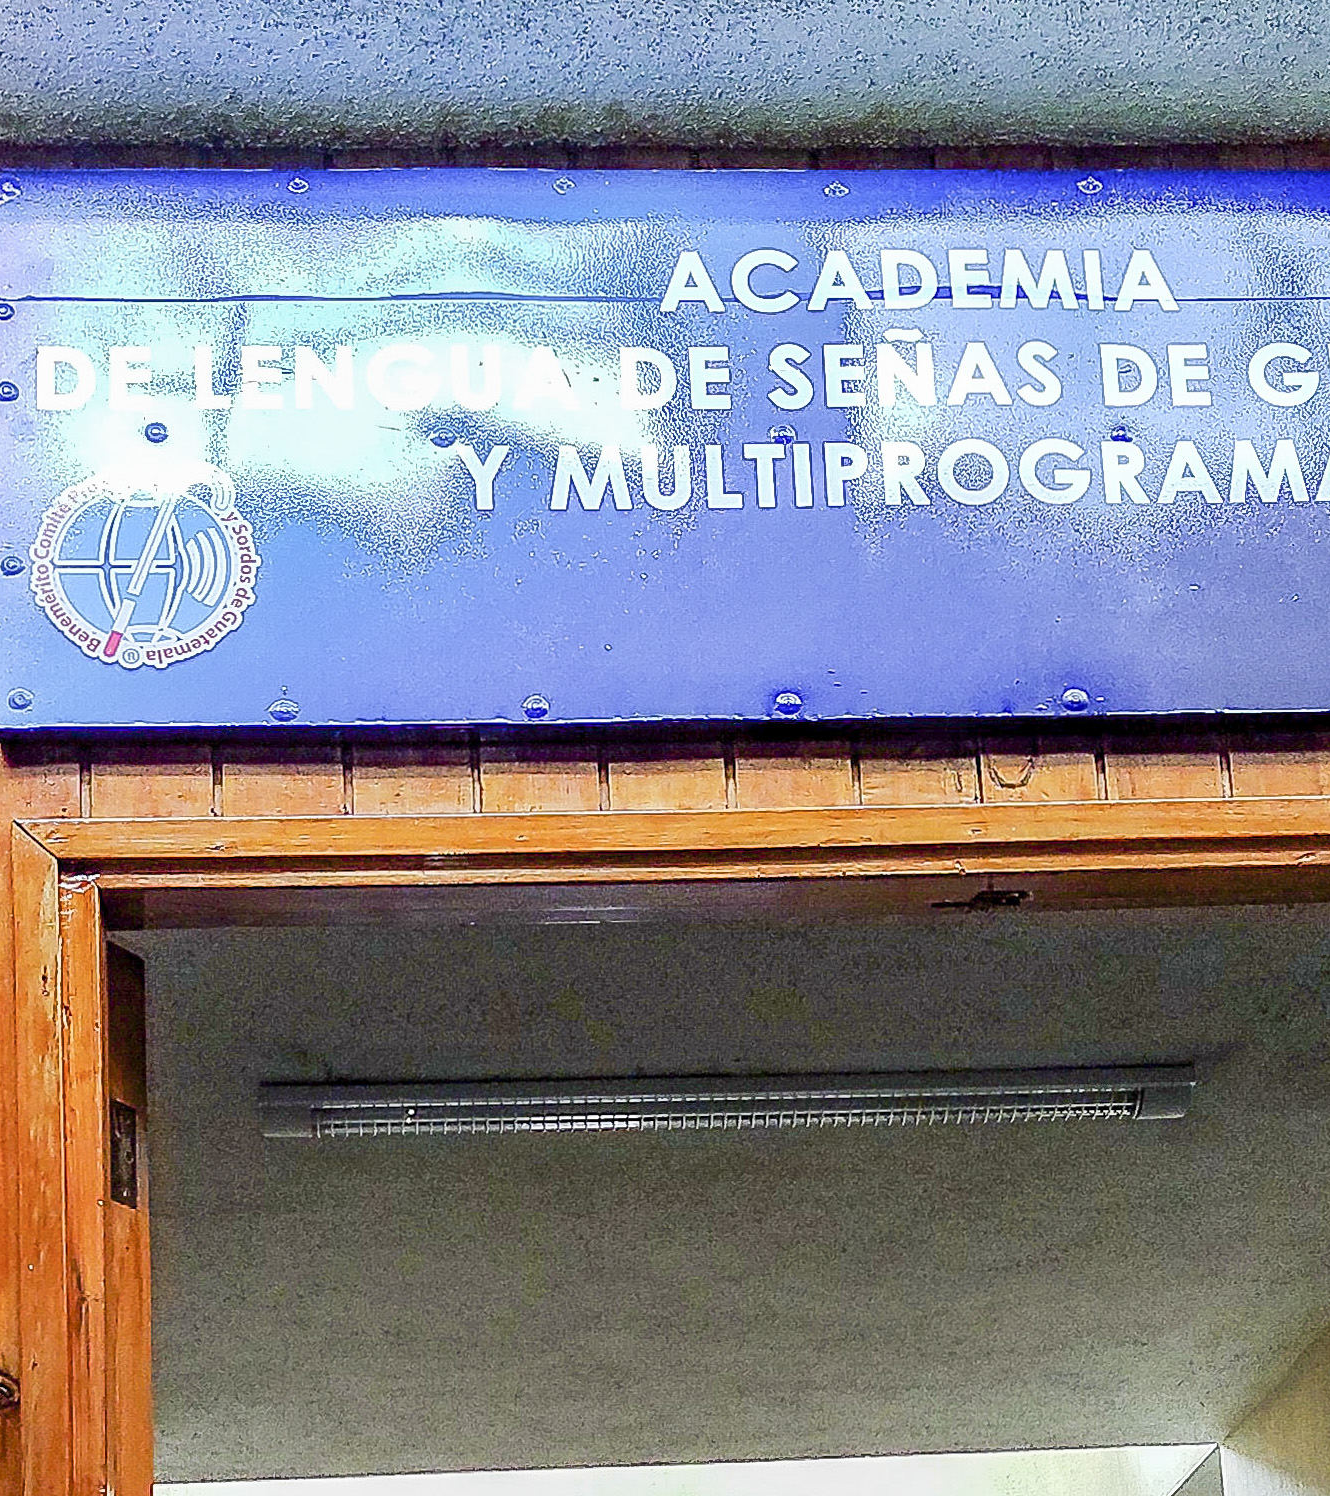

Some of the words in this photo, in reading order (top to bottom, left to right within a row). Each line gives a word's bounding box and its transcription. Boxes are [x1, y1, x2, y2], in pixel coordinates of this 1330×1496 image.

[659, 248, 1180, 313] ACADEMIA
[35, 344, 152, 411] DE
[194, 343, 584, 411] LENGUA
[620, 345, 732, 410] DE
[768, 327, 1063, 410] SEÑAS
[1099, 342, 1213, 407] DE
[458, 444, 510, 511] Y
[221, 512, 238, 522] y
[231, 524, 256, 584] Sordos
[35, 562, 102, 652] Benemérito
[230, 587, 252, 608] de
[146, 611, 238, 664] Guatemala
